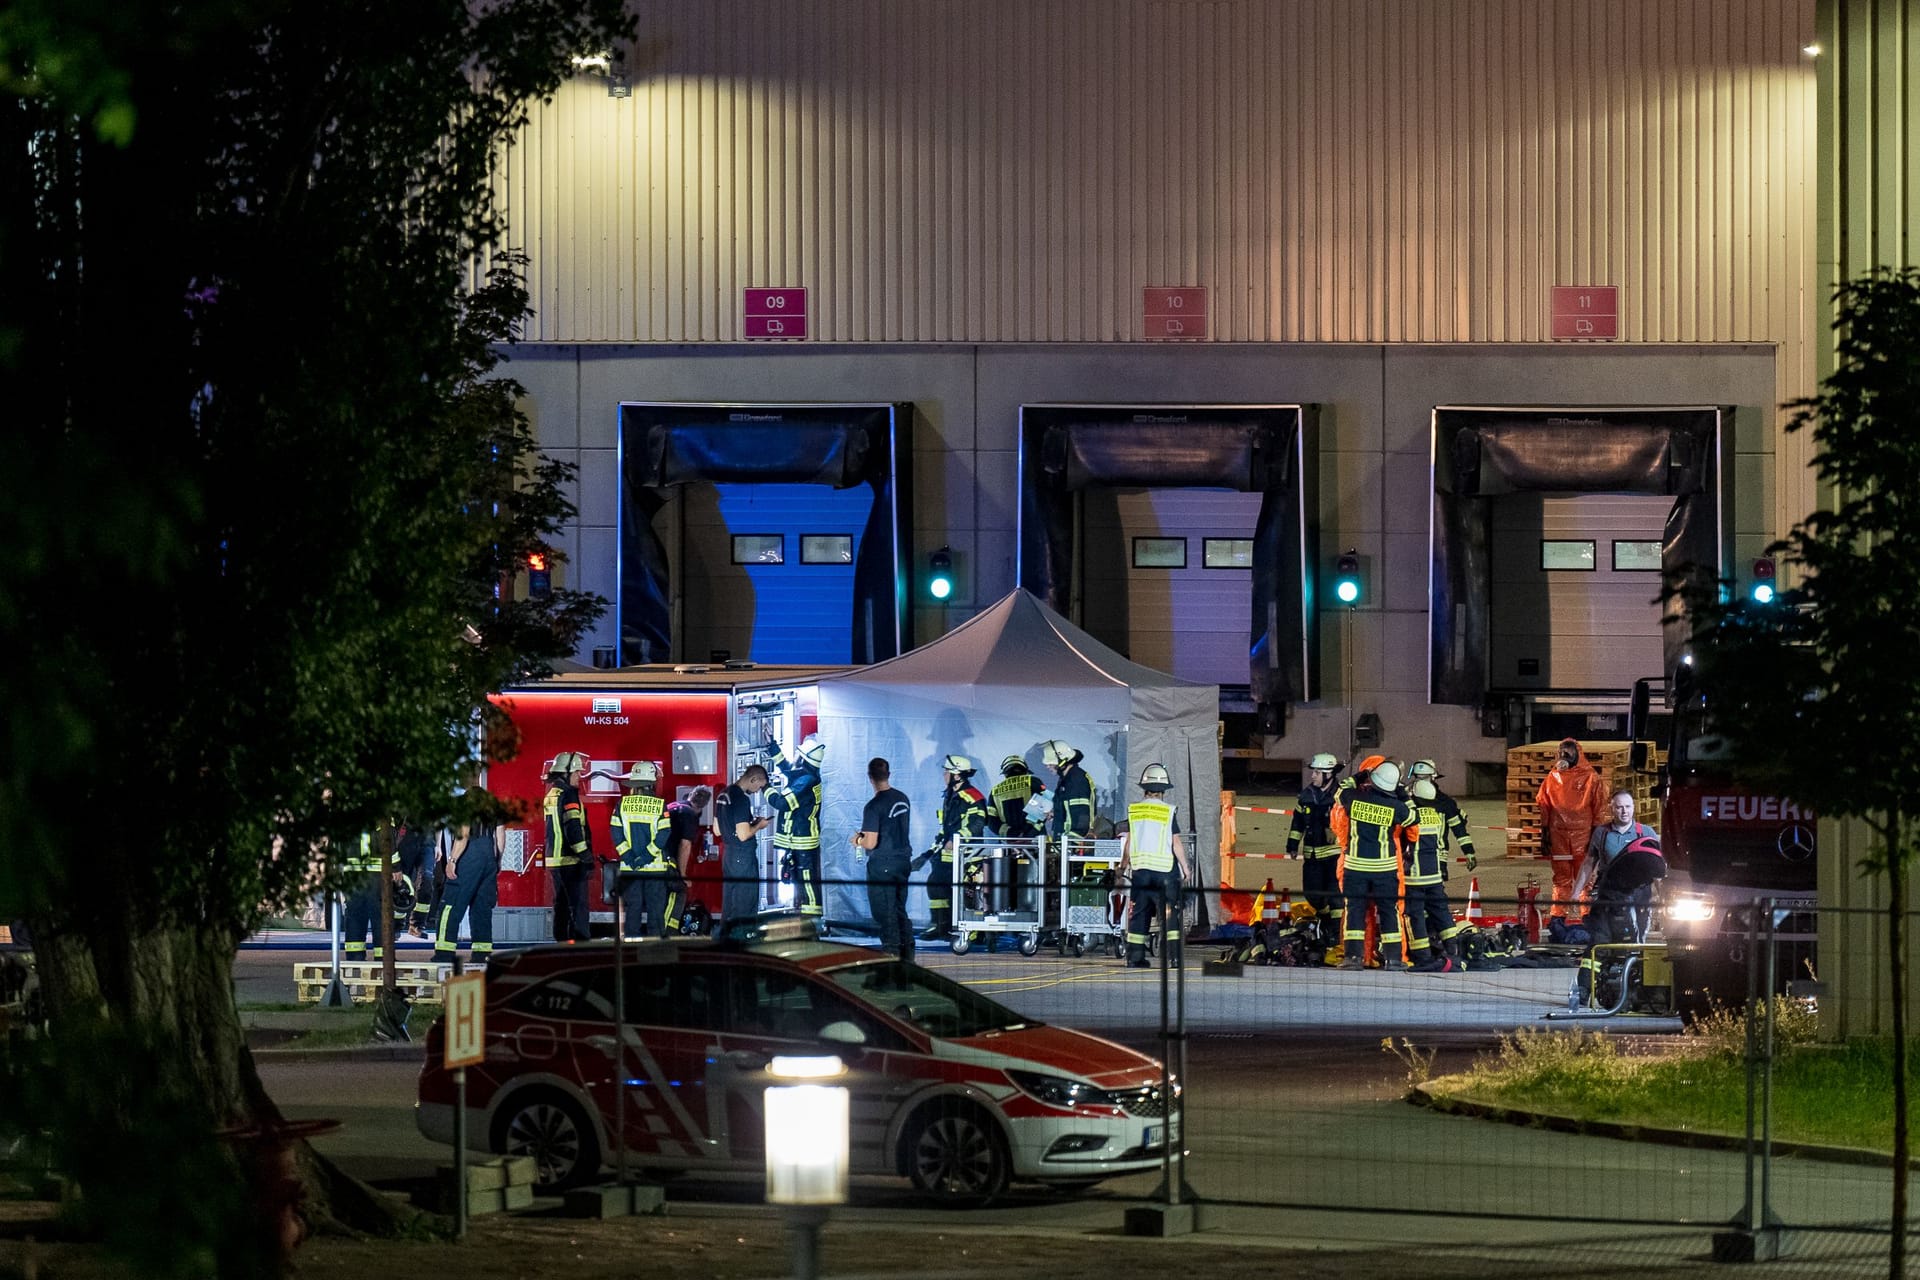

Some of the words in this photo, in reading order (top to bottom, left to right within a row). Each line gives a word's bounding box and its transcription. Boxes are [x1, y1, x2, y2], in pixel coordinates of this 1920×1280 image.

[766, 296, 785, 309] 09
[1167, 295, 1183, 308] 10
[1579, 295, 1591, 308] 11
[584, 716, 612, 725] WI-KS
[613, 716, 629, 725] 504
[623, 796, 662, 806] FEUERWEHR
[623, 804, 660, 814] WIESBADEN
[1353, 801, 1392, 817] FEUERWEHR
[1353, 810, 1391, 825] WIESBADEN
[549, 996, 571, 1010] 112
[456, 991, 474, 1048] H
